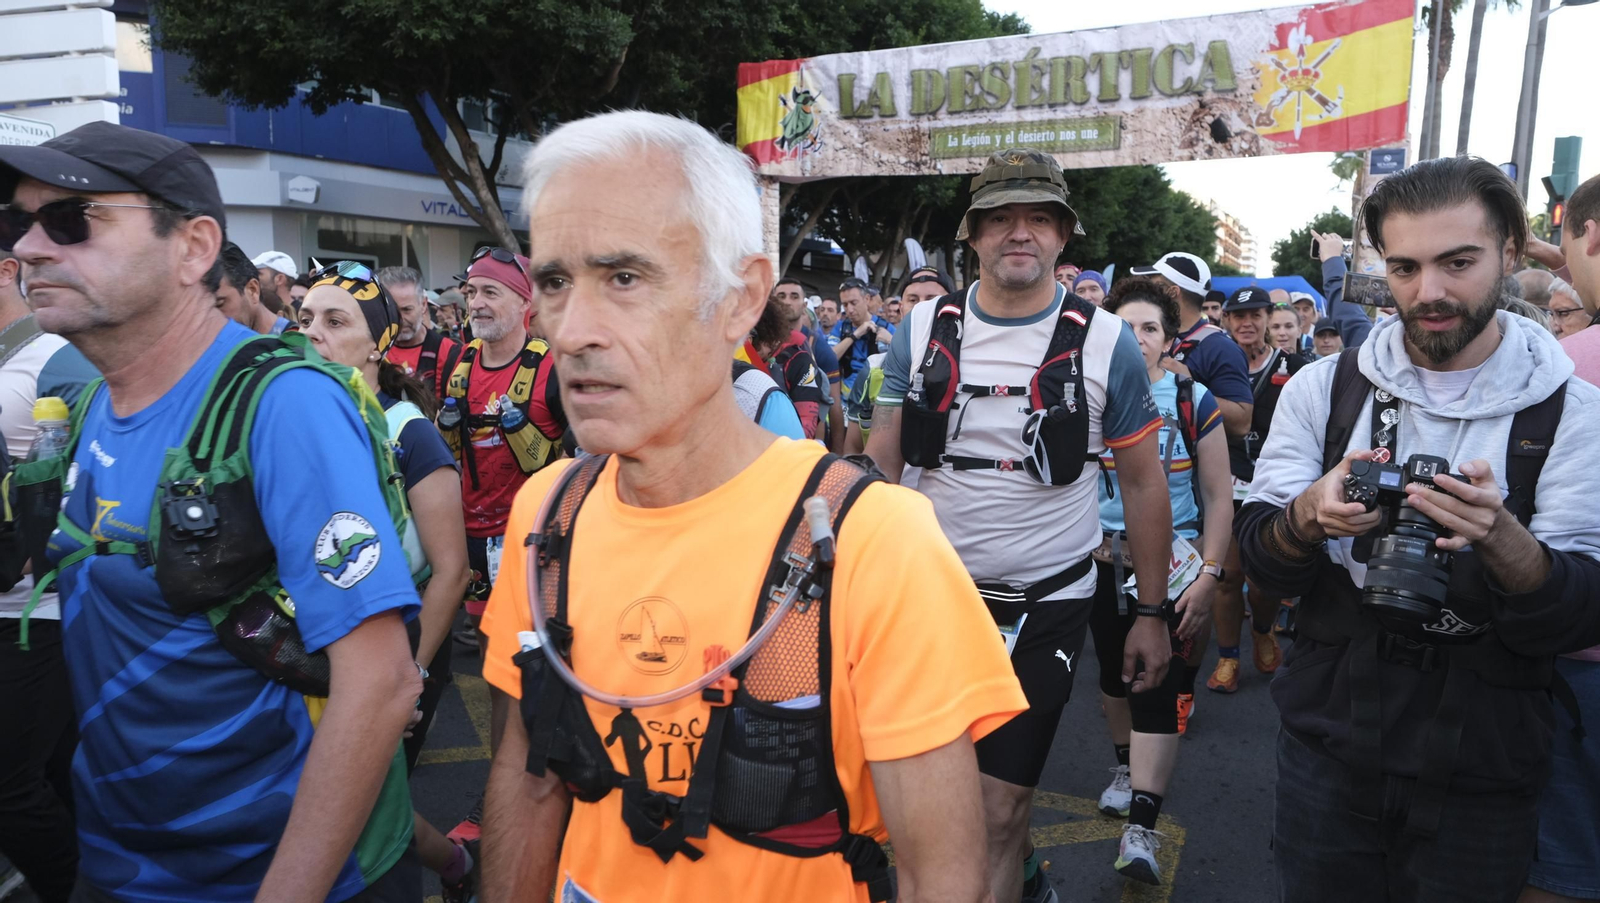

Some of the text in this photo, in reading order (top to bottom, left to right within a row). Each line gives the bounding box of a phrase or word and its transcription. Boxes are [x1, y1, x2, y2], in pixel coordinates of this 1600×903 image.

[837, 39, 1238, 119] LA DESÉRTICA
[947, 128, 1098, 148] La Legión y el desierto nos une
